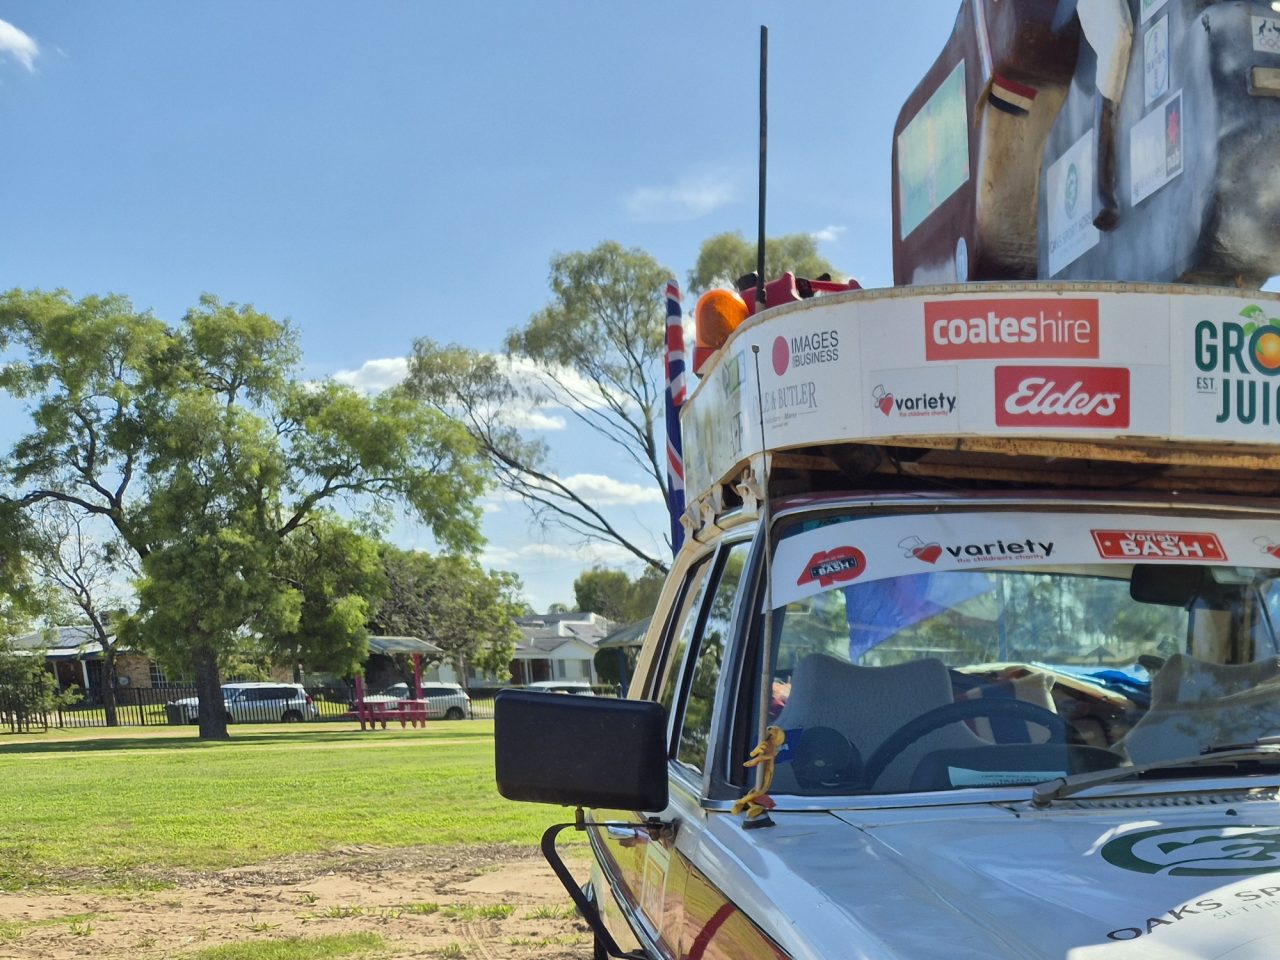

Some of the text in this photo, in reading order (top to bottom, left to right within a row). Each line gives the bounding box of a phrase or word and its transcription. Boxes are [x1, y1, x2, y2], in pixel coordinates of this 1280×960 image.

[791, 330, 839, 354] IMAGES
[795, 348, 839, 368] BUSINESS
[778, 381, 818, 410] BUTLER
[895, 392, 957, 413] variety
[1004, 377, 1121, 416] Elders
[945, 538, 1055, 558] variety
[1123, 532, 1180, 544] Variety
[1120, 539, 1204, 558] BASH
[818, 561, 850, 576] BASH
[1106, 898, 1223, 943] OAKS
